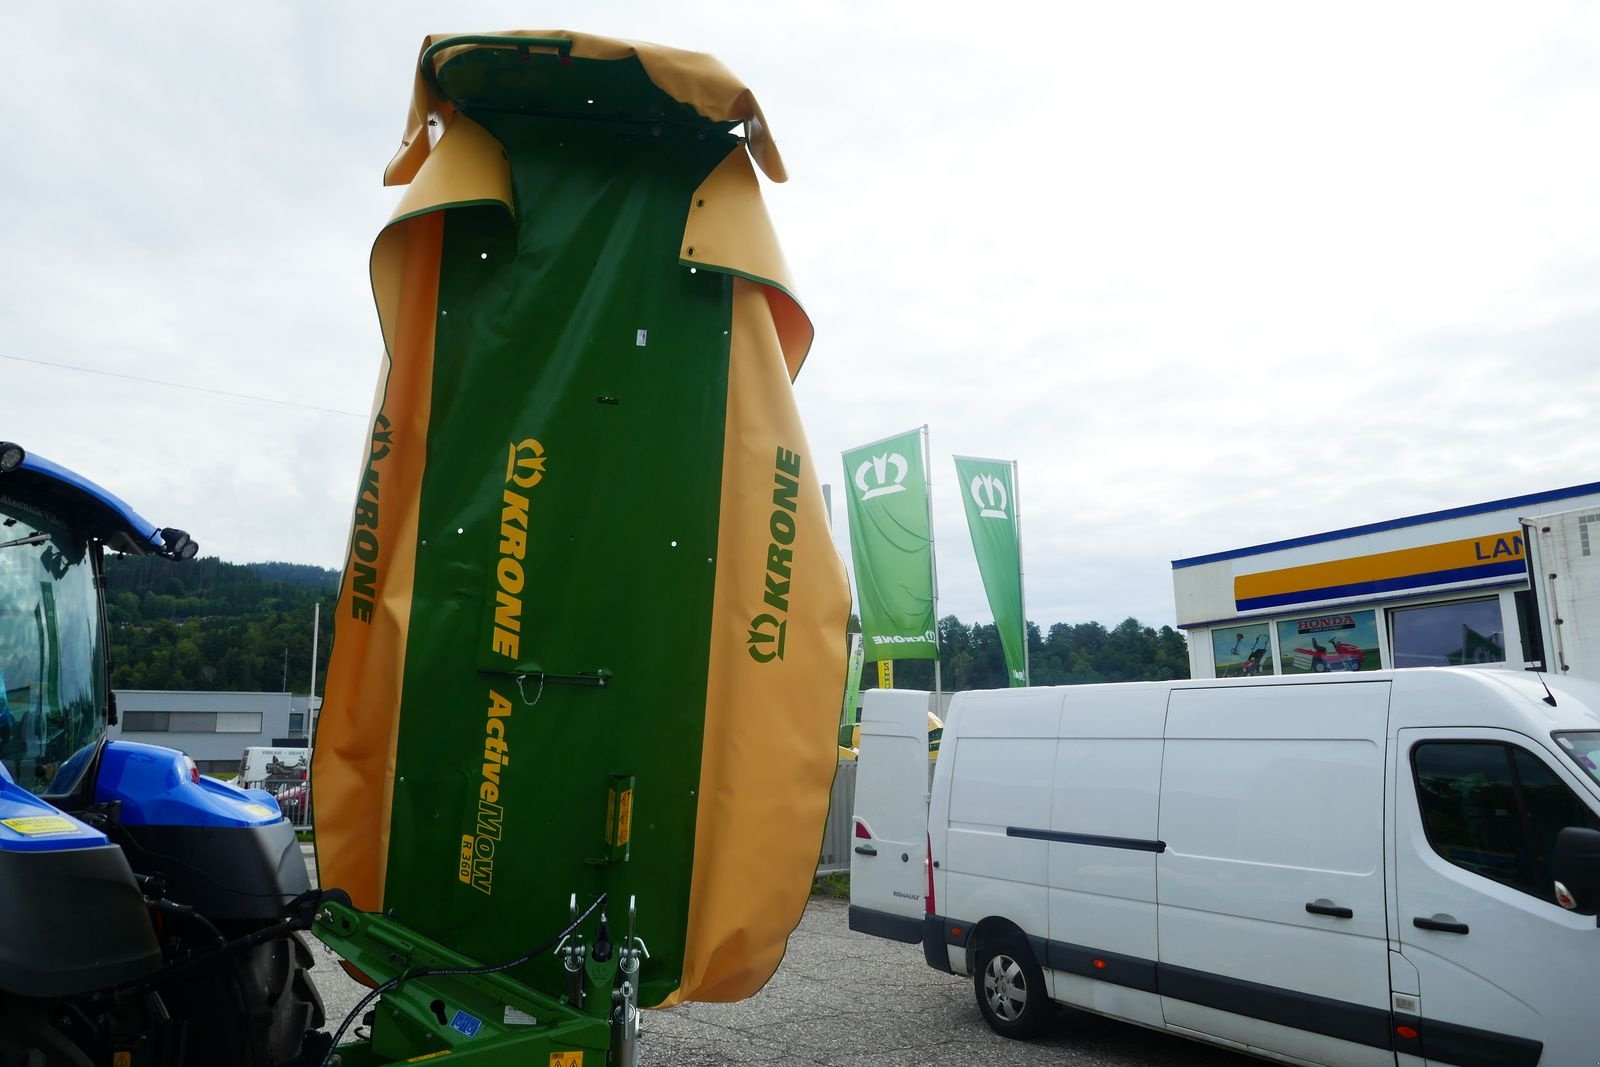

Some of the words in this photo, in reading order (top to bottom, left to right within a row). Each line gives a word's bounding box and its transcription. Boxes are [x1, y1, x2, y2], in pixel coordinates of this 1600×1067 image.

[763, 445, 801, 613] KRONE
[492, 489, 530, 660] KRONE
[1298, 615, 1355, 629] HONDA
[463, 840, 472, 850] R
[460, 854, 471, 878] 360
